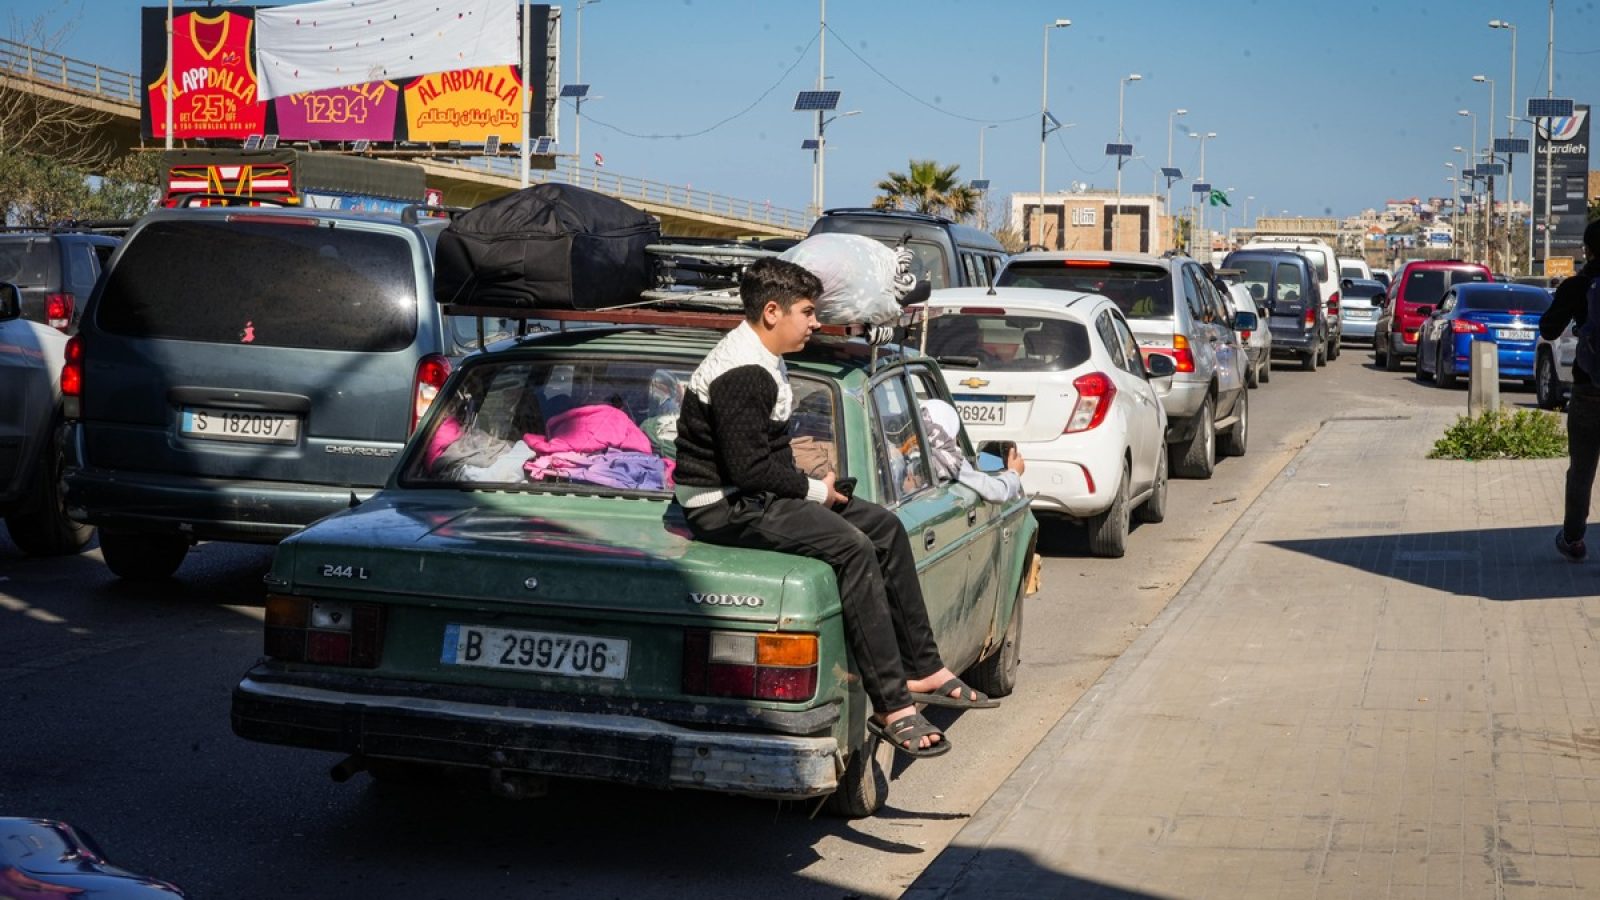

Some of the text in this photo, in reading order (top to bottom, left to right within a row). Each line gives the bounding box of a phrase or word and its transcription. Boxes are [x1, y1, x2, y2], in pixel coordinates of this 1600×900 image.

[304, 96, 367, 123] 1294
[197, 412, 285, 436] S 182097
[325, 445, 398, 457] CHEVROLET
[323, 564, 368, 579] 244 L
[689, 592, 760, 606] VOLVO
[465, 630, 608, 673] B 299706
